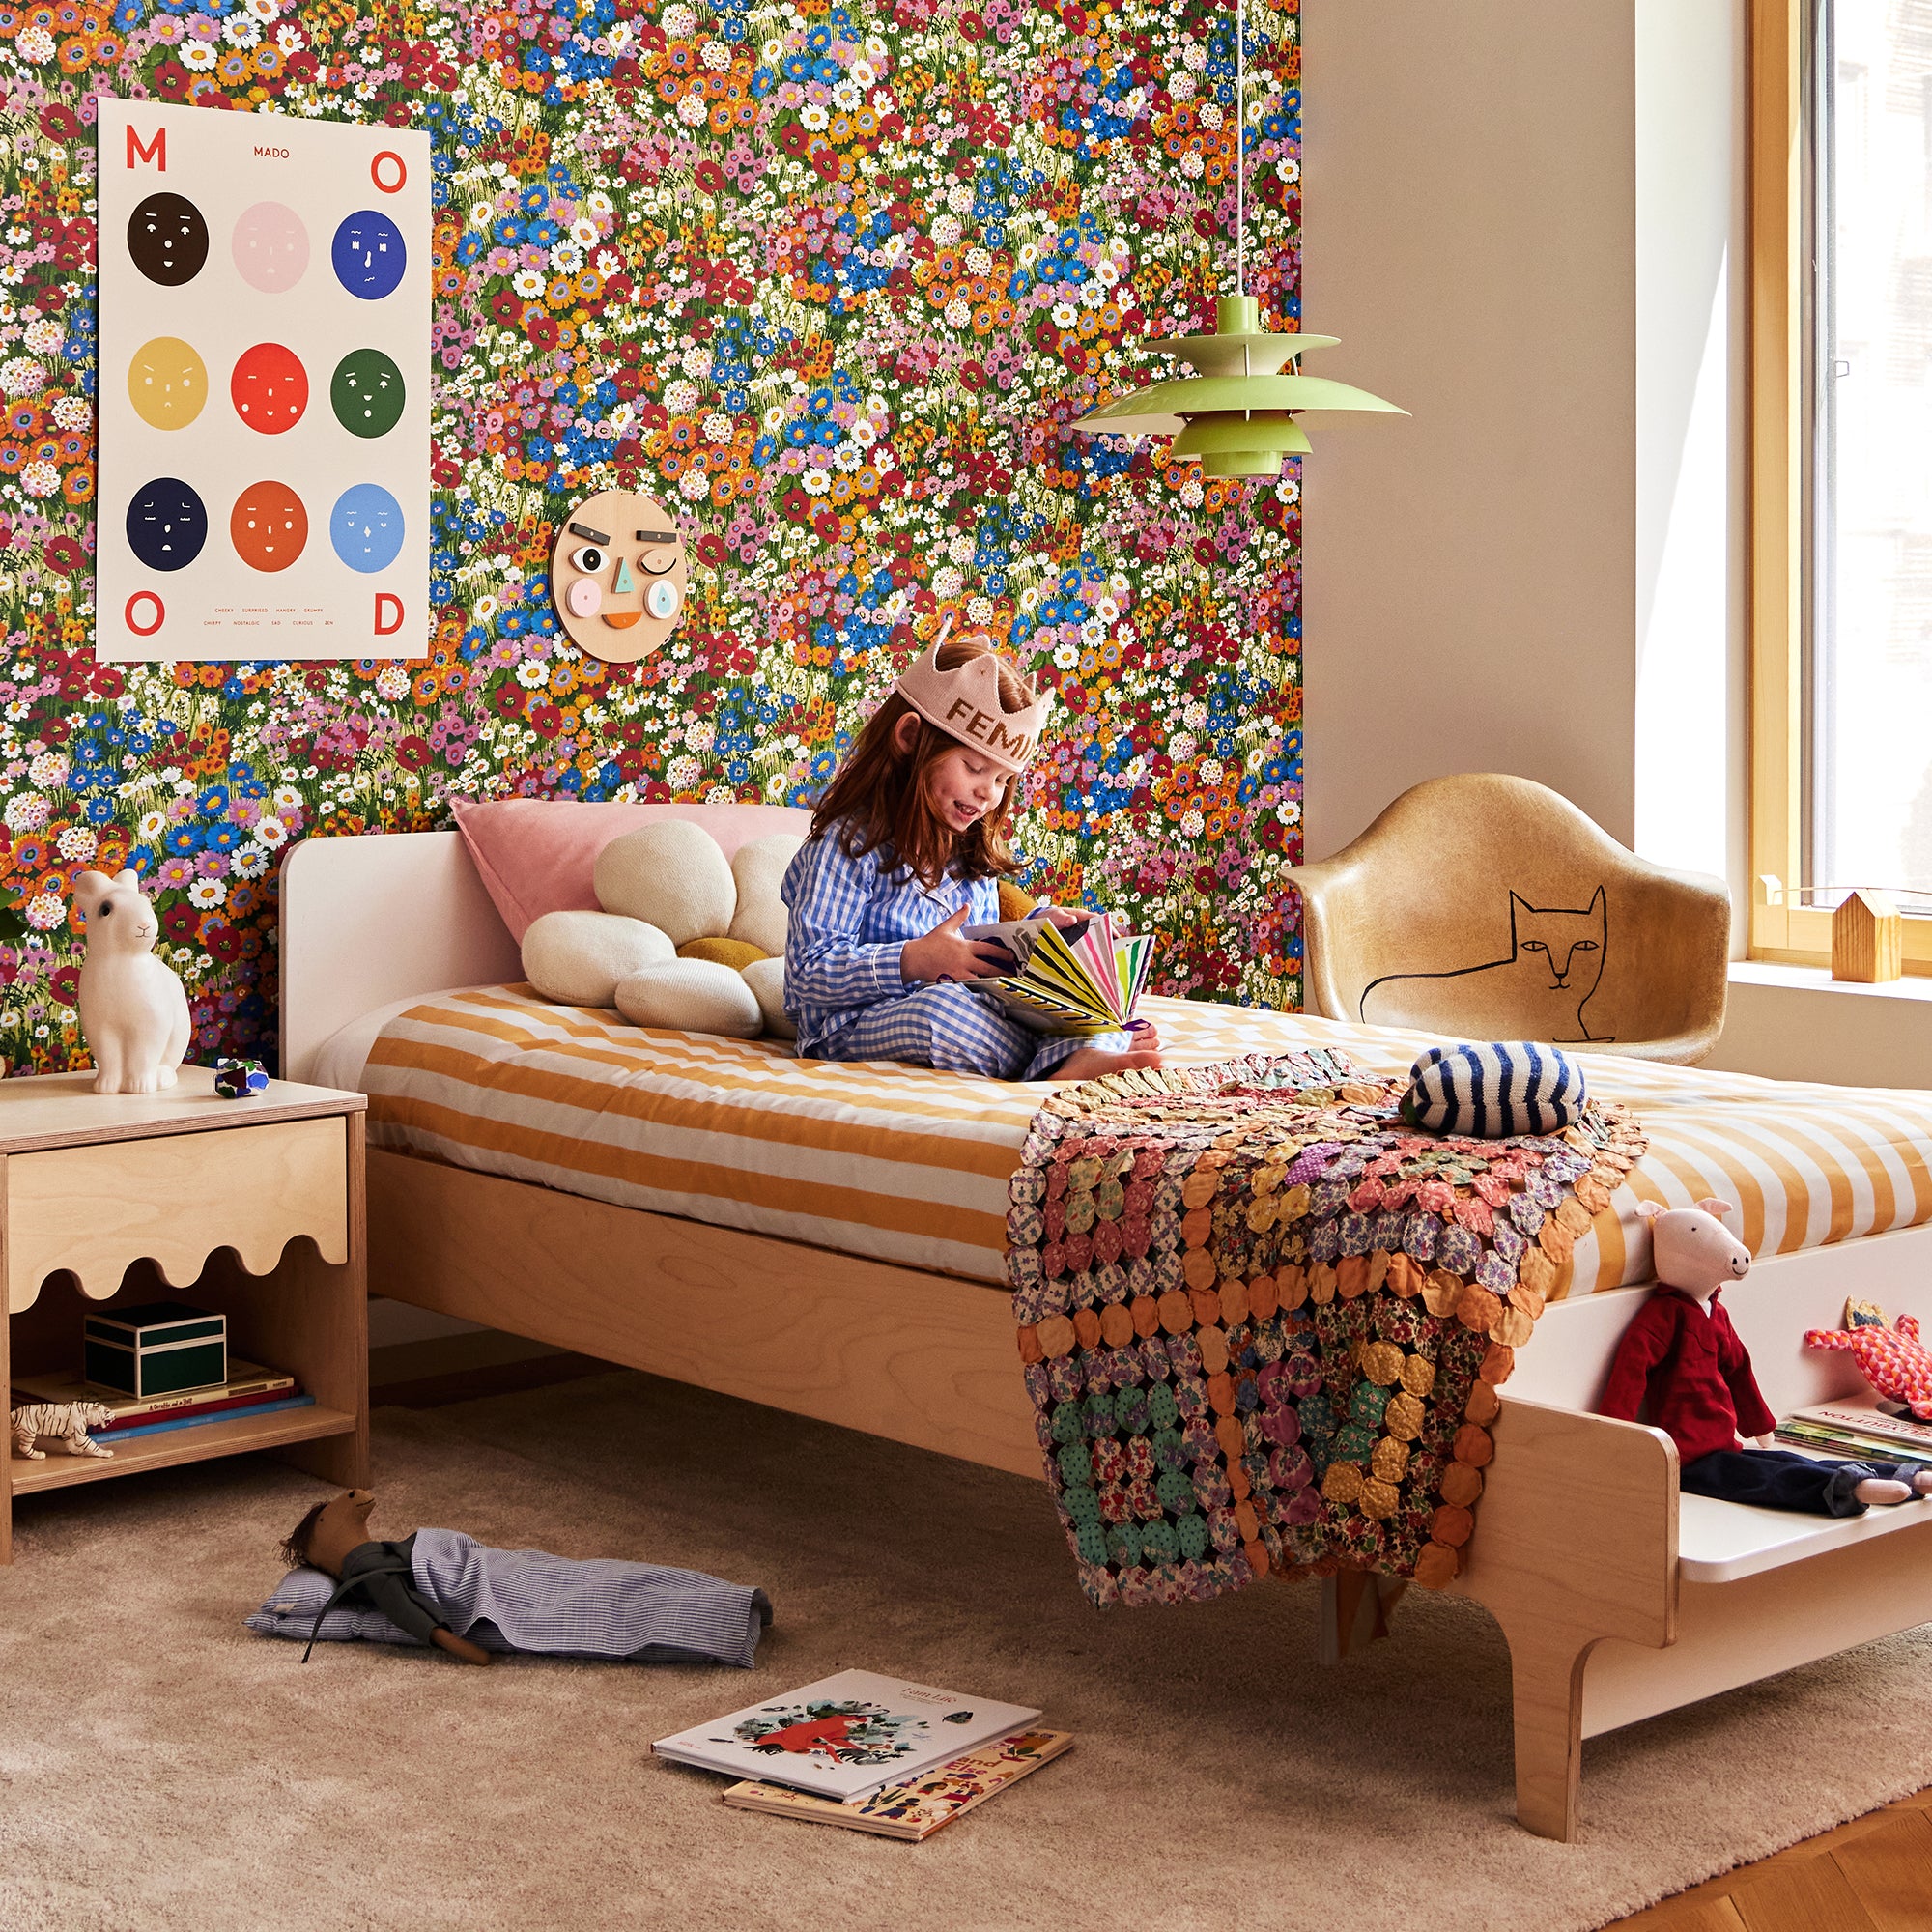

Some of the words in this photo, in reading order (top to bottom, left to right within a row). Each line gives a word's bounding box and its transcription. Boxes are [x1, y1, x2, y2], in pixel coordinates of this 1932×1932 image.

[126, 124, 167, 173] M
[253, 145, 290, 159] MADO
[370, 150, 408, 194] O
[124, 590, 166, 637] O
[373, 592, 405, 636] D
[944, 1761, 988, 1776] Else
